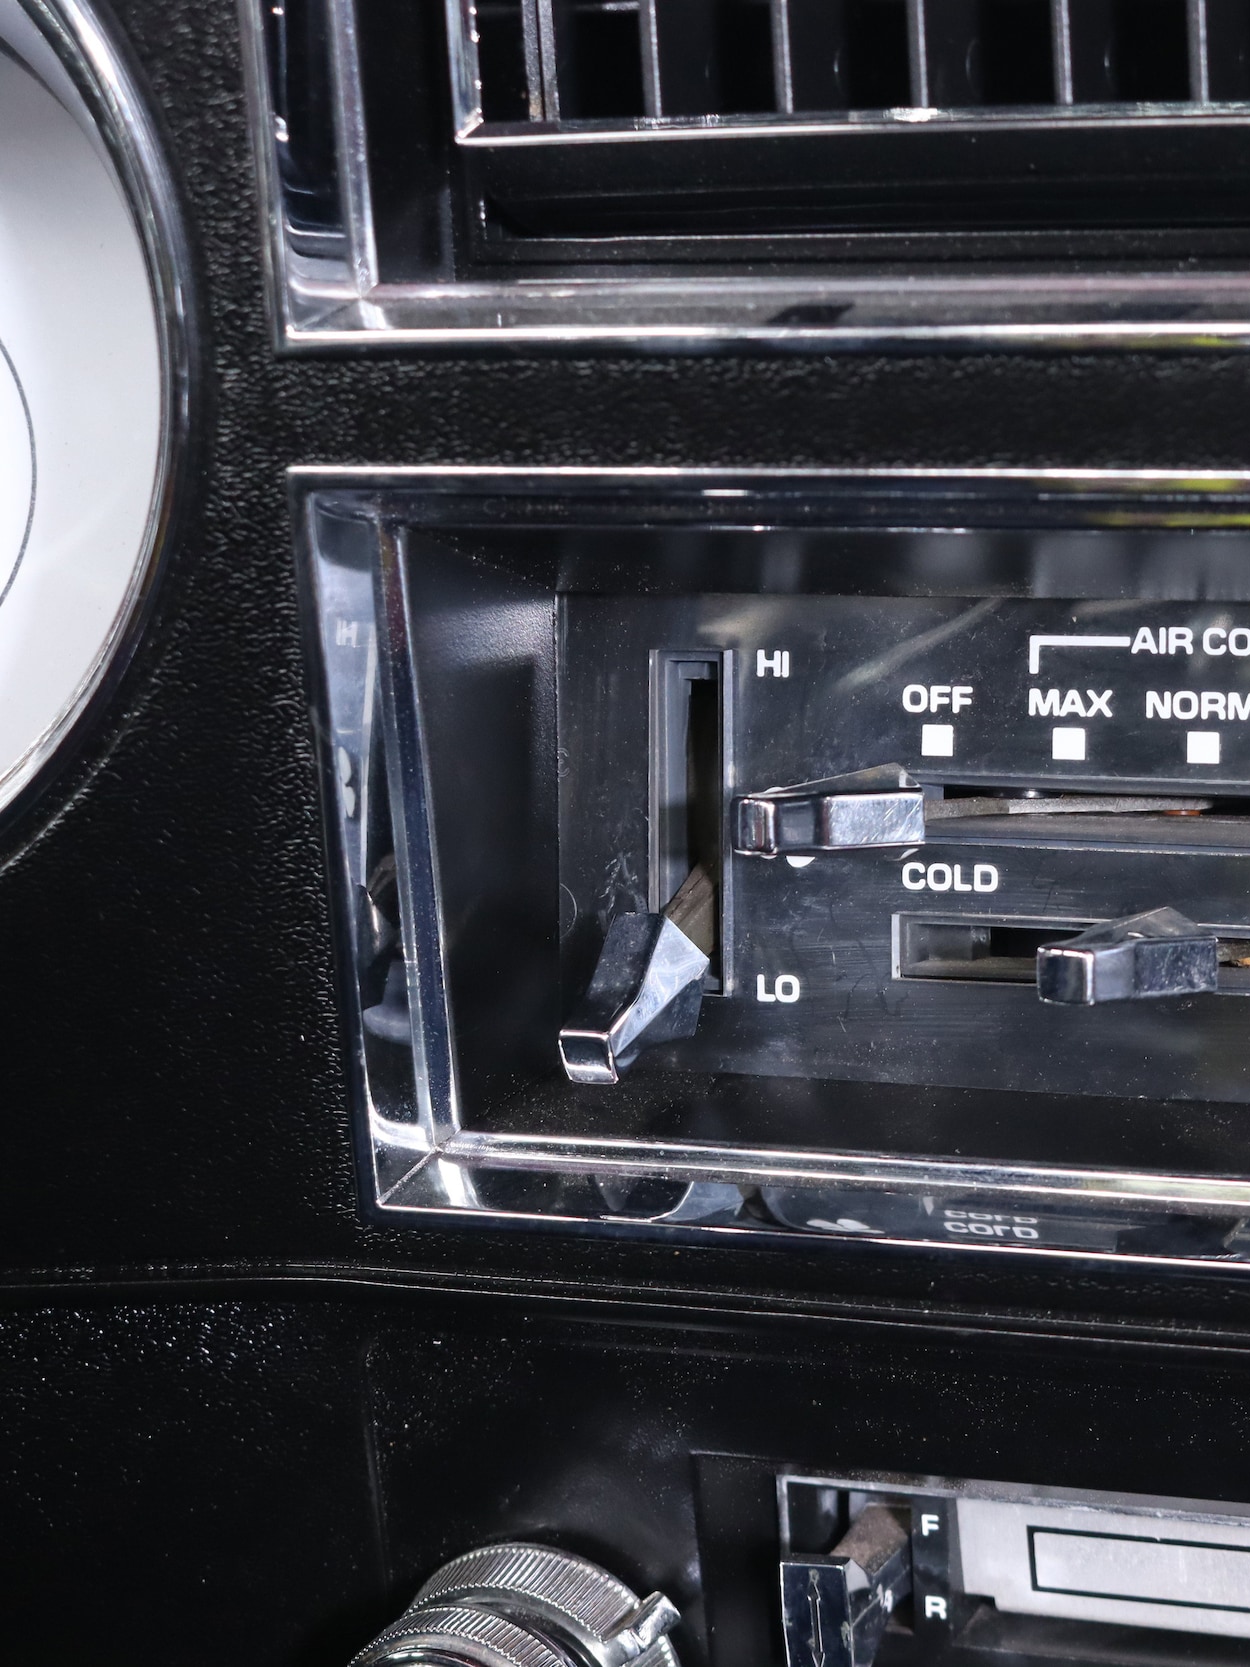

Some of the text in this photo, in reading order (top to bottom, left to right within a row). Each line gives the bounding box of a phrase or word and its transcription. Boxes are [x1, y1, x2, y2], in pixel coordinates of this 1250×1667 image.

[1129, 626, 1195, 656] AIR
[755, 648, 791, 679] HI
[901, 683, 974, 715] OFF
[1027, 687, 1113, 719] MAX
[900, 861, 1000, 893] COLD
[755, 973, 801, 1004] LO
[920, 1513, 940, 1537] F
[924, 1595, 948, 1621] R
